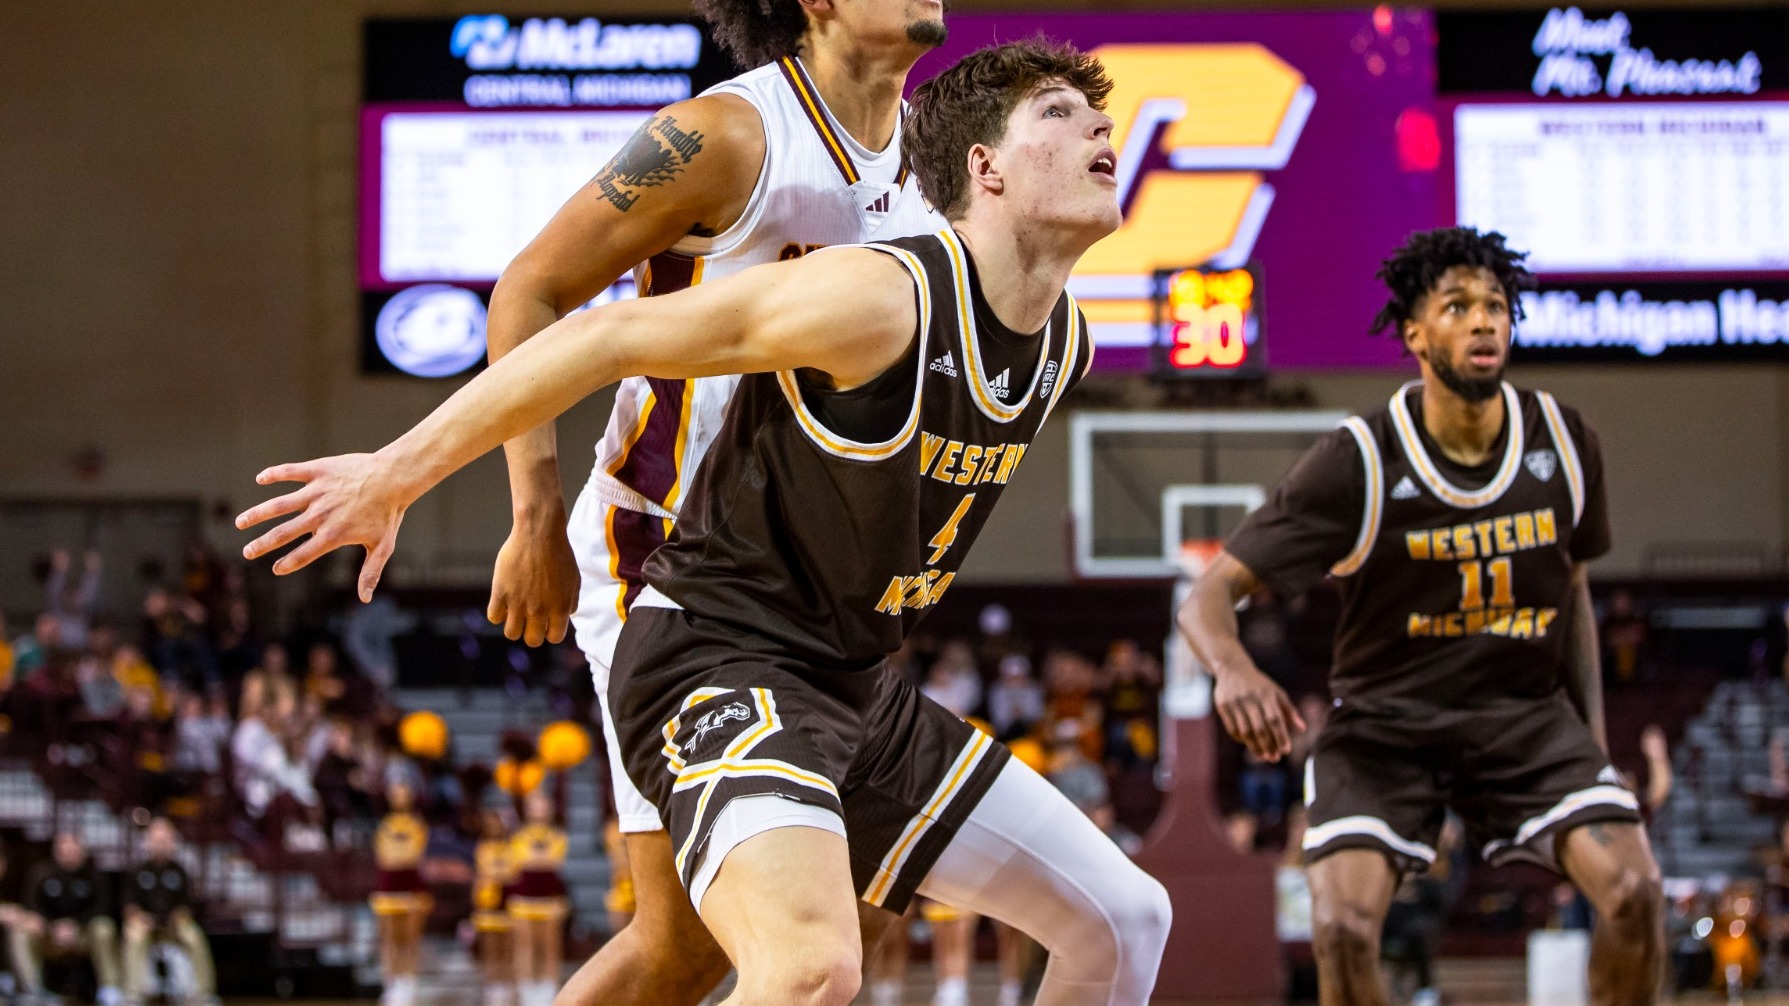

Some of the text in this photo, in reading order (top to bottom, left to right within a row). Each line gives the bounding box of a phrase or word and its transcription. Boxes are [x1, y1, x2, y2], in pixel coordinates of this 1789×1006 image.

[516, 17, 702, 69] McLaren
[464, 73, 692, 106] CENTRAL MICHIGAN
[1605, 48, 1762, 97] Pleasant
[1168, 302, 1247, 369] 30
[1515, 290, 1718, 356] Michigan
[929, 361, 958, 378] adidas
[927, 493, 976, 566] 4
[1406, 507, 1558, 561] WESTERN
[1458, 556, 1516, 611] 11
